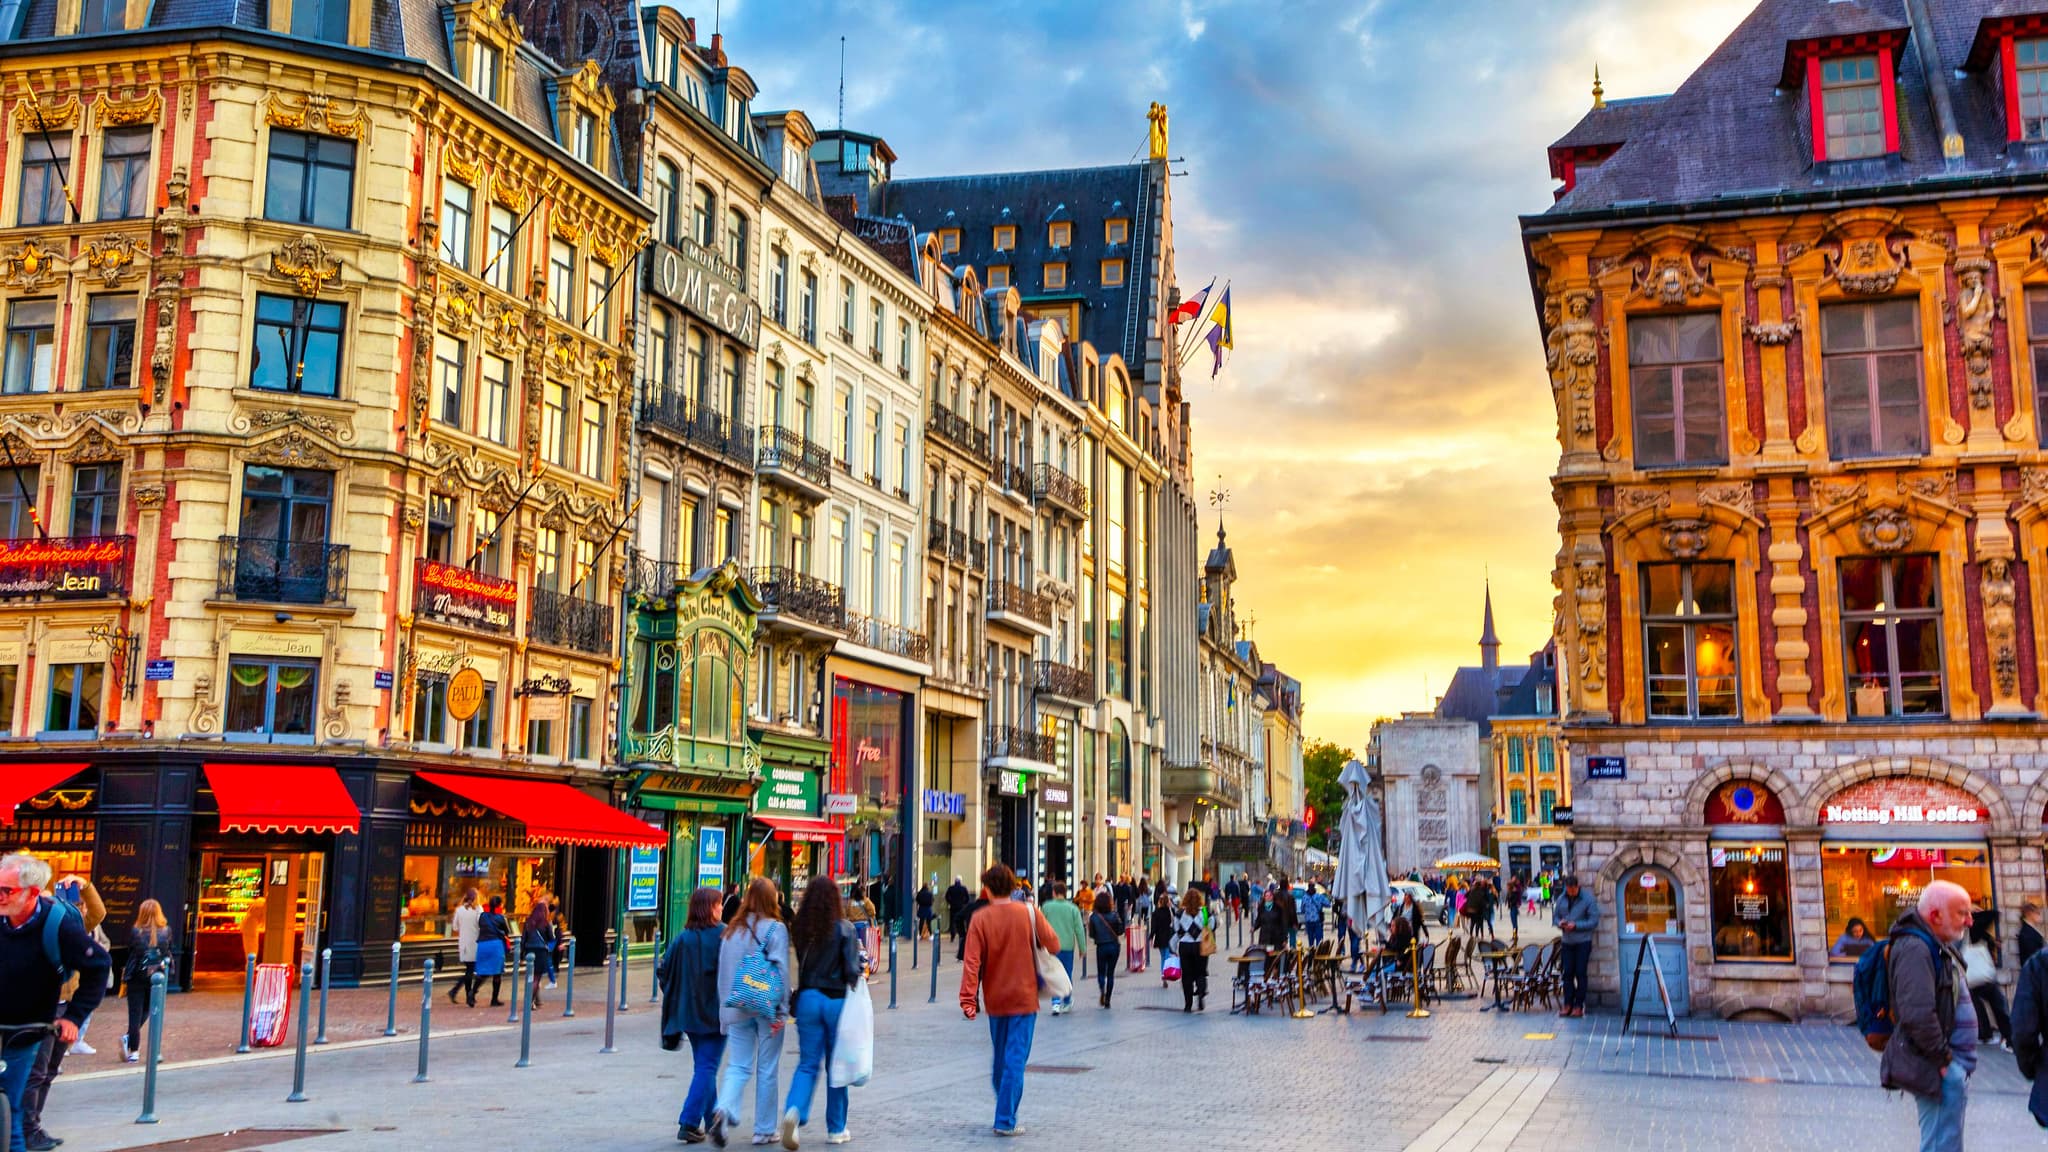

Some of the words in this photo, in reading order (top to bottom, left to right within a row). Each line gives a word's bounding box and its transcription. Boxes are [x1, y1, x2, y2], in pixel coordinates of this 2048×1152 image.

[689, 243, 738, 287] MONTRE
[663, 251, 753, 343] OMEGA
[96, 541, 121, 561] de
[57, 572, 100, 591] Jean
[484, 604, 509, 626] Jean
[286, 640, 312, 653] Jean
[452, 685, 480, 702] PAUL
[856, 739, 880, 766] free
[1827, 806, 1890, 824] Notting
[1893, 806, 1923, 822] Hill
[1925, 806, 1977, 822] coffee
[109, 843, 136, 856] PAUL
[1725, 850, 1759, 864] otting
[633, 877, 639, 886] A
[701, 878, 705, 887] A
